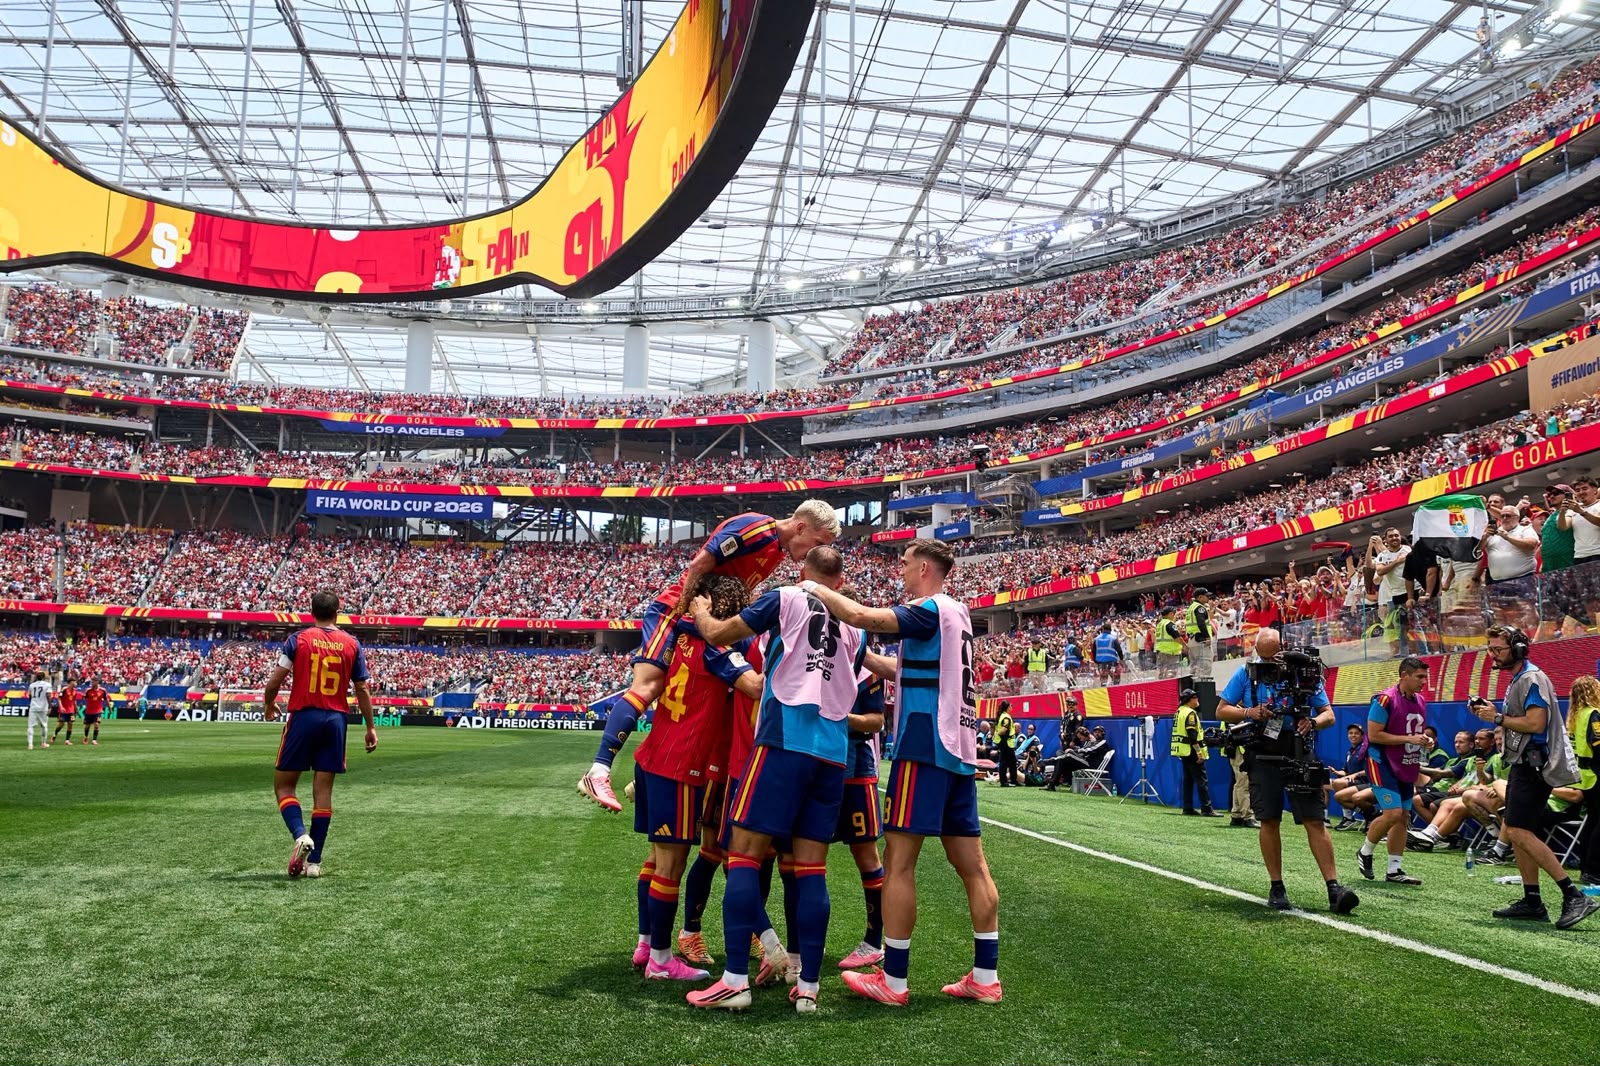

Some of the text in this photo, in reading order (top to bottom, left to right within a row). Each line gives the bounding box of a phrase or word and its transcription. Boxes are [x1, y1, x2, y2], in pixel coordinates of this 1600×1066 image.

[1305, 356, 1405, 405] LOS ANGELES
[1551, 356, 1600, 389] #FIFAWorl
[366, 425, 465, 437] LOS ANGELES
[406, 417, 435, 425] GOAL
[542, 420, 570, 428] GOAL
[1172, 472, 1197, 487] GOAL
[1275, 437, 1303, 455] GOAL
[1512, 436, 1572, 470] GOAL
[377, 484, 406, 492] GOAL
[542, 488, 570, 496] GOAL
[316, 496, 484, 513] FIFA WORLD CUP 2026
[1033, 583, 1053, 597] GOAL
[360, 616, 391, 625] GOAL
[527, 620, 558, 629] GOAL
[309, 652, 342, 696] 16
[33, 686, 44, 698] 17
[659, 662, 690, 723] 4
[1125, 689, 1148, 709] GOAL
[175, 709, 213, 722] ADI
[457, 716, 491, 729] ADI
[494, 718, 595, 730] PREDICTSTREET
